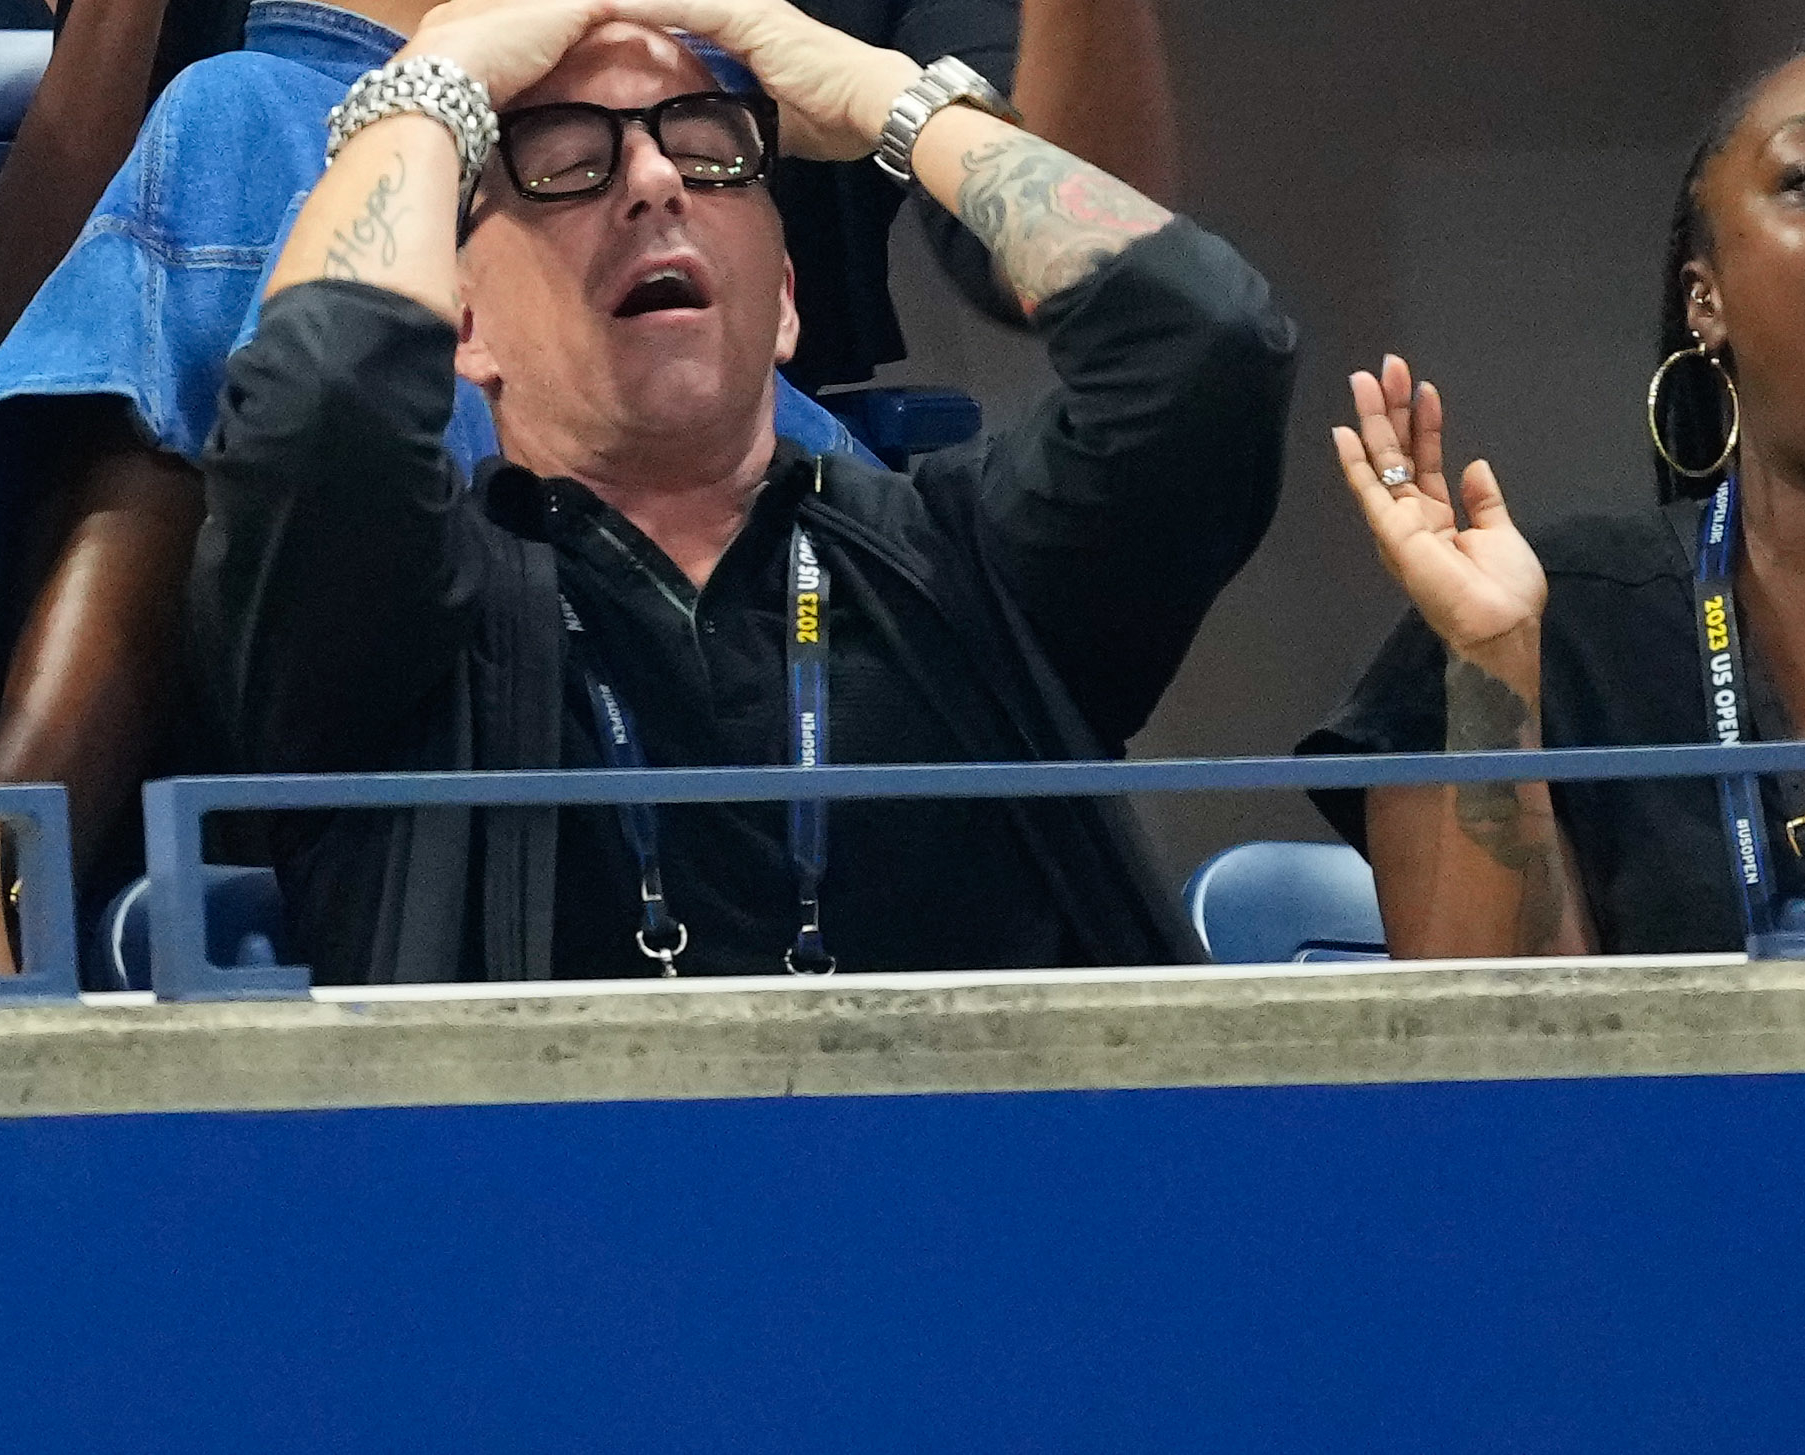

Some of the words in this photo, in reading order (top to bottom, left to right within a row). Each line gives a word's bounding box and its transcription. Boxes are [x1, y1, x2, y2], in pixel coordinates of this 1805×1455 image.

[798, 564, 821, 590] US
[797, 593, 819, 644] 2023
[1704, 595, 1729, 651] 2023
[1710, 652, 1733, 686] US
[1714, 689, 1741, 748] OPEN
[1736, 818, 1759, 885] #USOPEN
